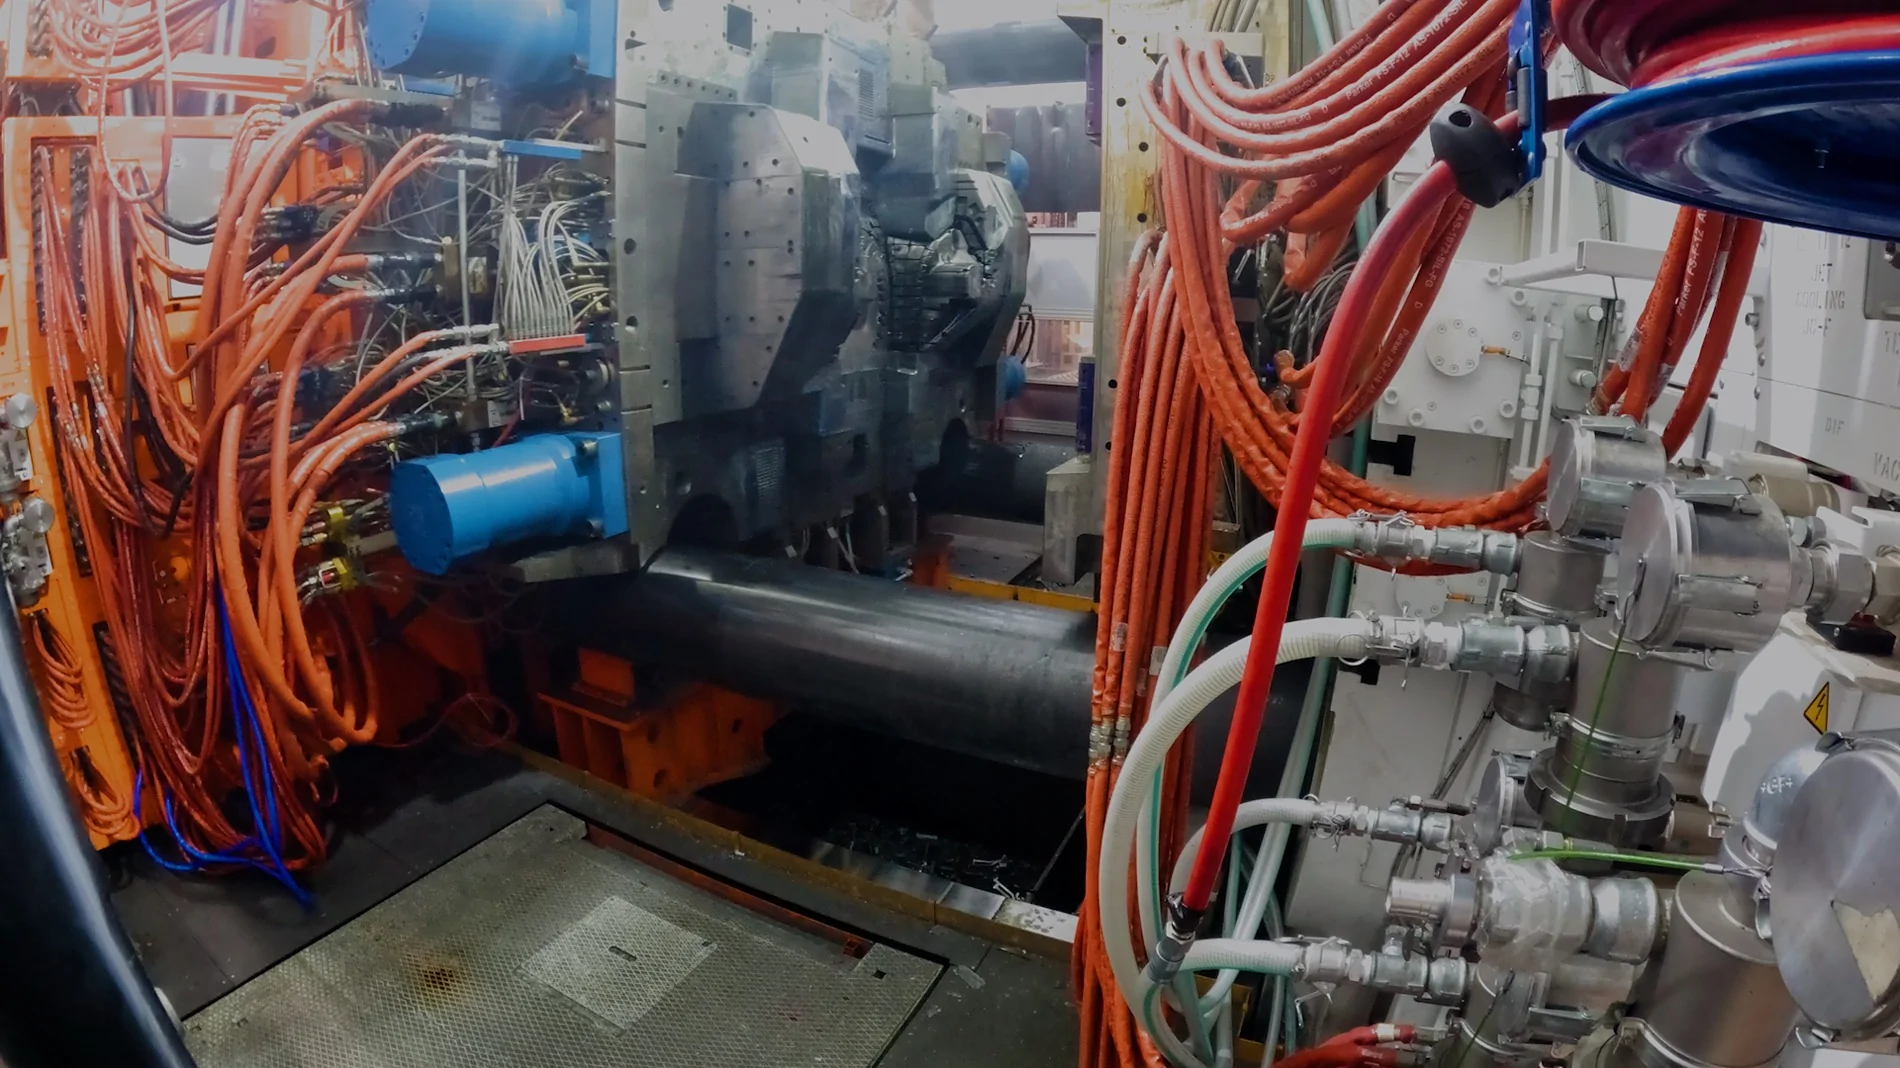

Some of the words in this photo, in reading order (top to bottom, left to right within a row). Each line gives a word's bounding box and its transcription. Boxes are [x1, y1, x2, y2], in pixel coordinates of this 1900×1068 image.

[1345, 79, 1374, 101] Parker
[1376, 49, 1411, 80] FS-F-12
[1676, 279, 1693, 318] Parker
[1686, 227, 1704, 276] FS-F-12
[1795, 290, 1845, 310] COOLING
